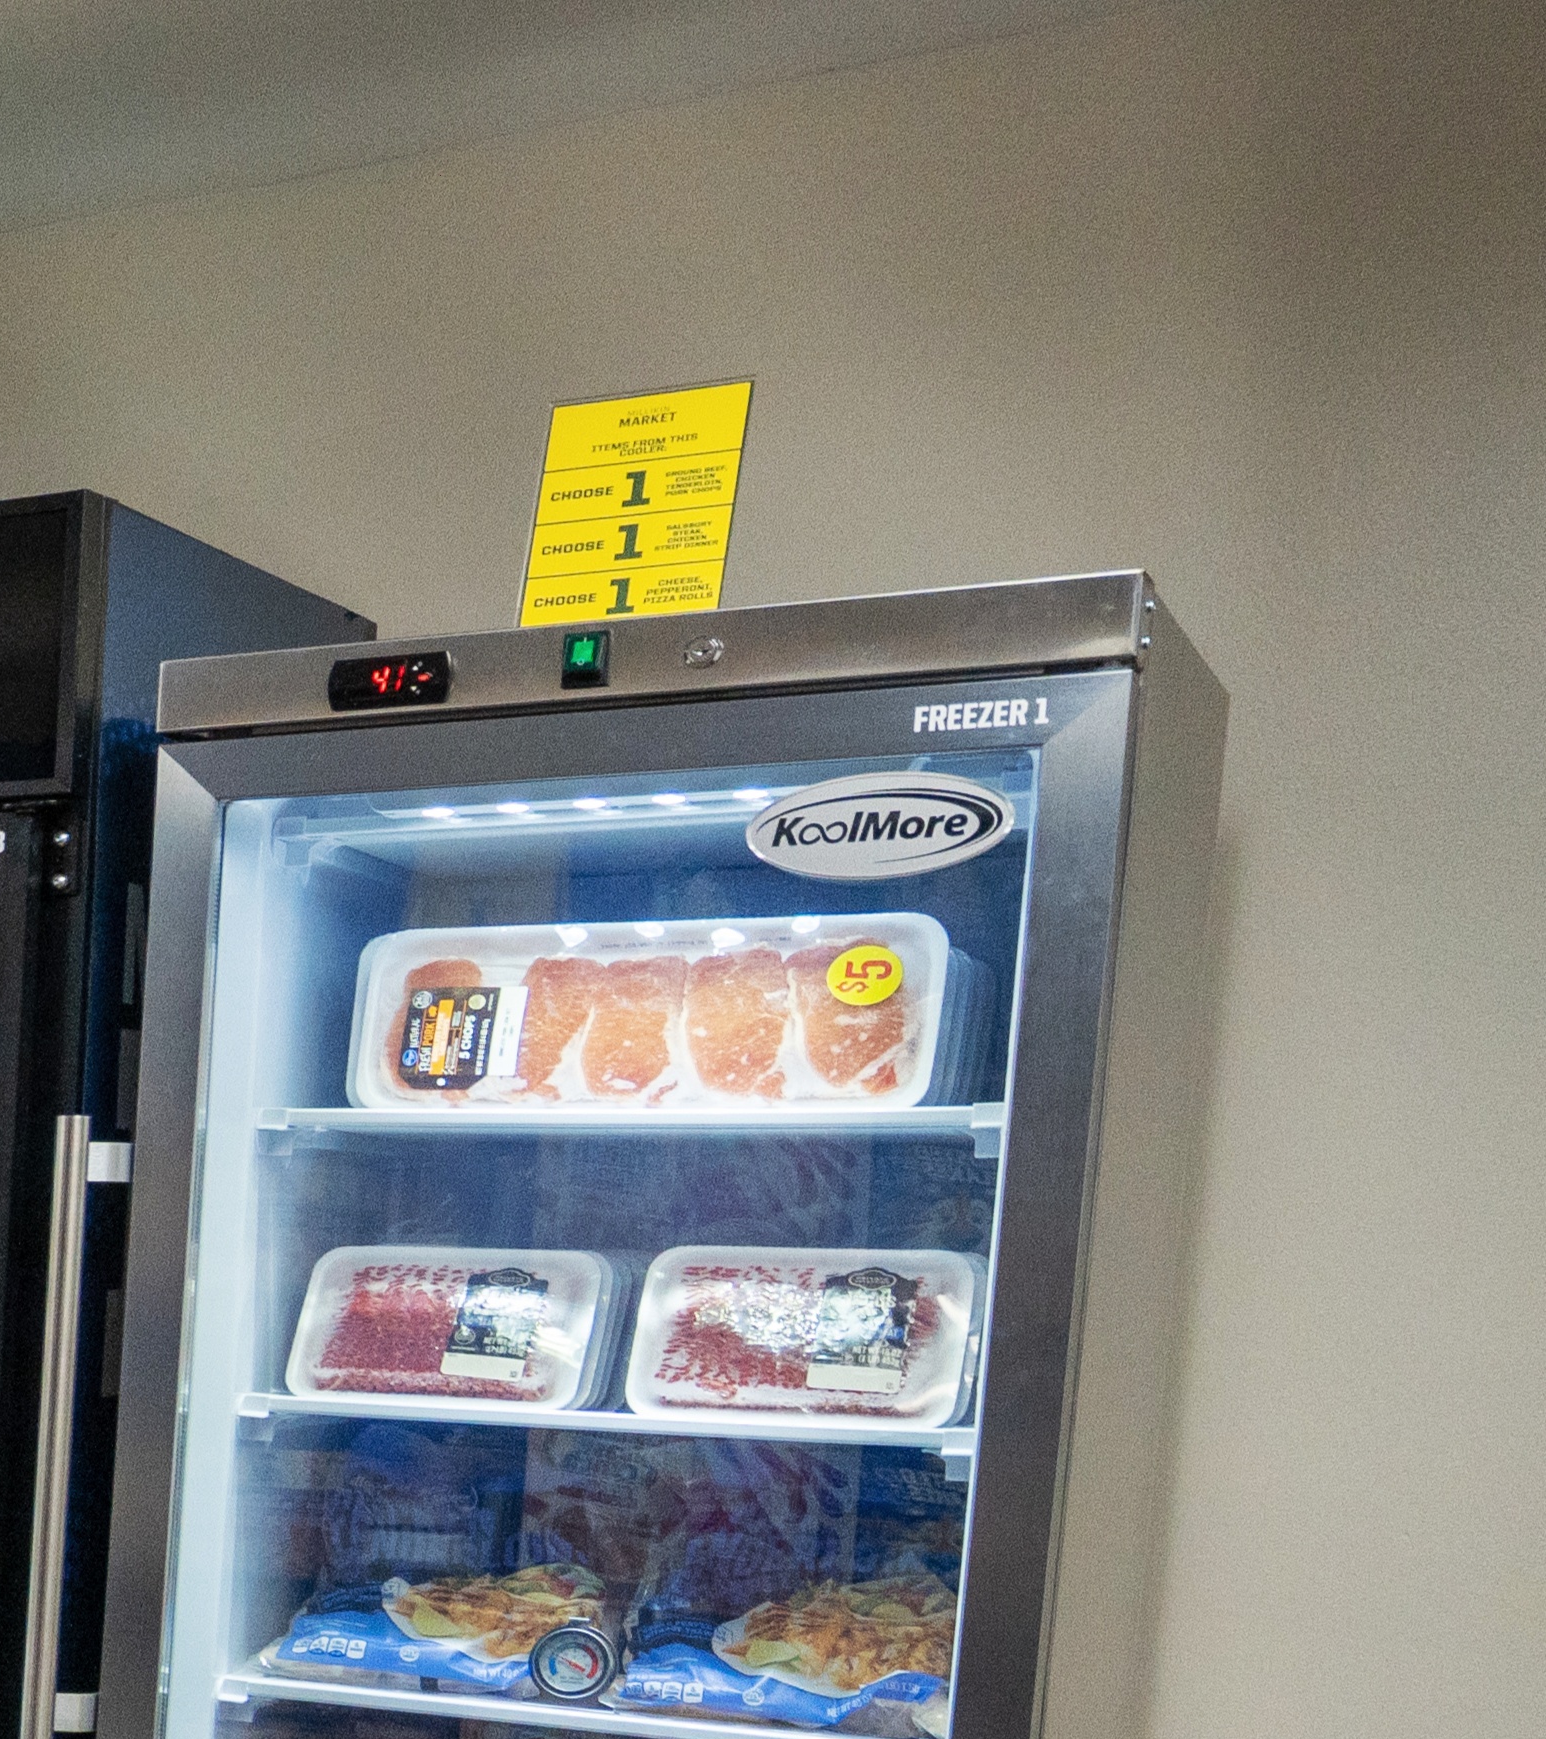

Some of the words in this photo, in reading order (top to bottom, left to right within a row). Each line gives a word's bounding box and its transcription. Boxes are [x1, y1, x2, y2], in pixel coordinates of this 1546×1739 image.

[619, 412, 677, 428] MARKET
[591, 442, 629, 453] ITEMS
[632, 437, 666, 449] FROM
[670, 432, 698, 442] THIS
[665, 468, 702, 477] GROUND
[675, 473, 716, 482] CHICKEN
[550, 486, 614, 502] CHOOSE
[621, 470, 651, 508] 1
[691, 485, 721, 494] CHOPS
[541, 540, 605, 556] CHOOSE
[614, 523, 643, 561] 1
[667, 535, 707, 543] CHICKEN
[684, 540, 718, 548] DINNER
[533, 593, 597, 608] CHOOSE
[605, 577, 635, 615] 1
[643, 595, 676, 604] PIZZA
[679, 591, 714, 601] ROLLS
[371, 665, 406, 694] 41
[913, 698, 1028, 733] FREEZER
[1033, 698, 1049, 725] 1
[771, 810, 969, 848] KoolMore
[836, 959, 893, 993] $5
